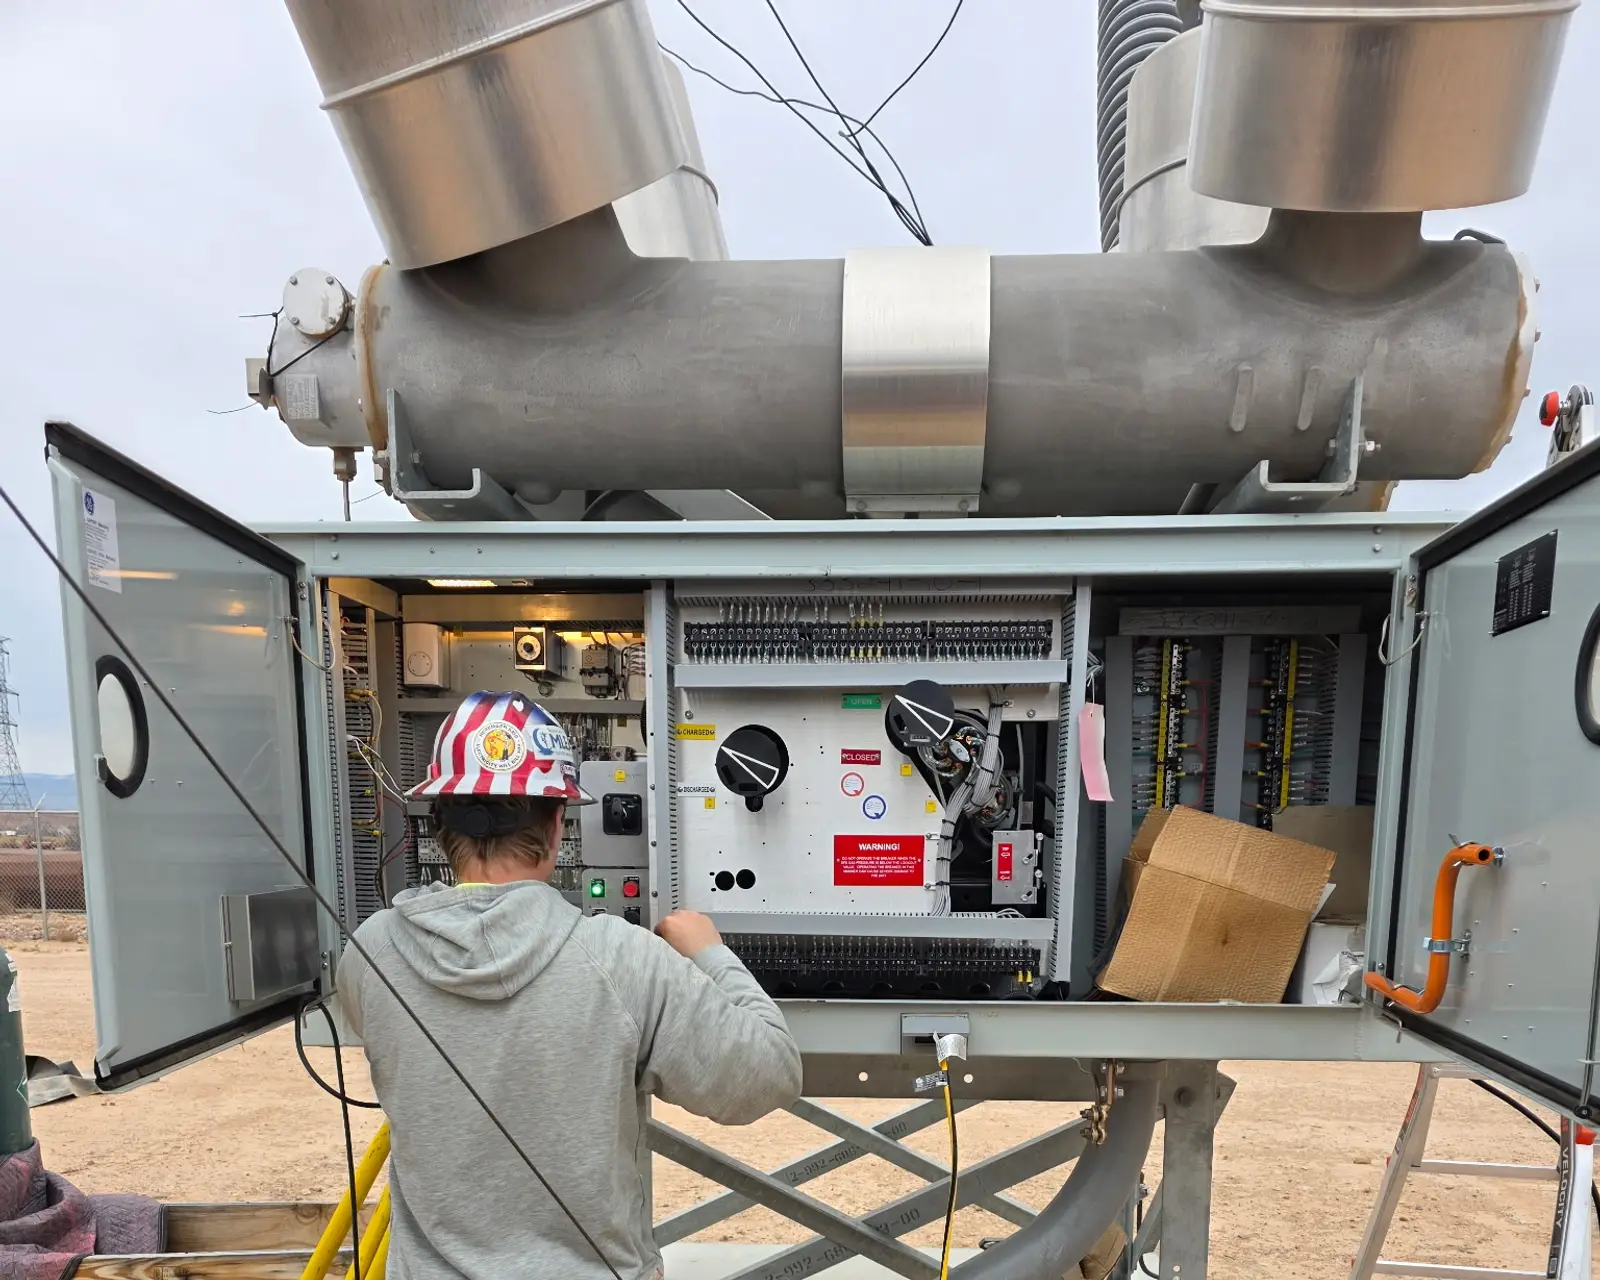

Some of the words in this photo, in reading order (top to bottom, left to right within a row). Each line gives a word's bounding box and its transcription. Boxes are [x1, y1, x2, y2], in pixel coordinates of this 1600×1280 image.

[846, 754, 876, 762] CLOSED
[858, 843, 900, 851] WARNING!
[1555, 1146, 1569, 1230] VELOCITY
